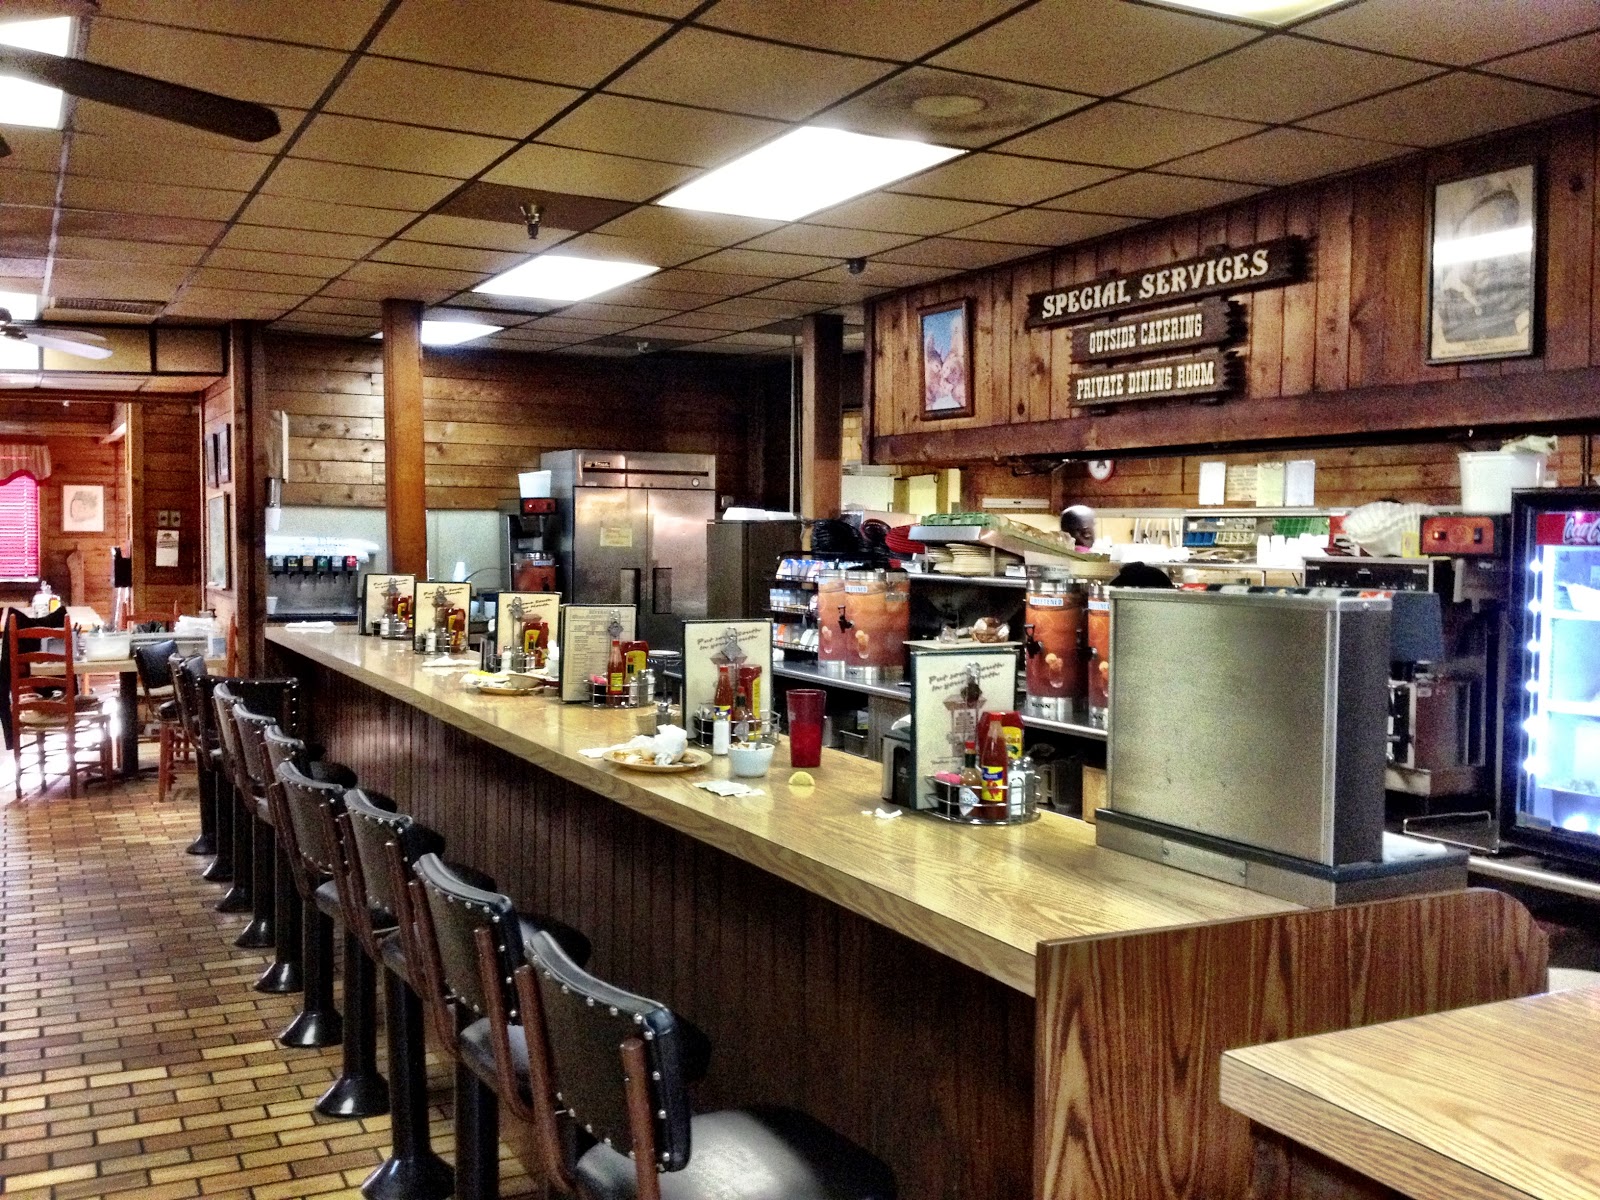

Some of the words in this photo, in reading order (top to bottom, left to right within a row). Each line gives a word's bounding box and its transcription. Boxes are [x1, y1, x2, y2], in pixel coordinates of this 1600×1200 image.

[1042, 279, 1131, 319] SPECIAL
[1138, 249, 1269, 299] SERVICES
[1089, 327, 1136, 354] OUTSIDE
[1140, 313, 1203, 345] CATERING
[1076, 373, 1124, 400] PRIVATE
[1128, 367, 1173, 395] DINING
[1176, 361, 1215, 389] ROOM
